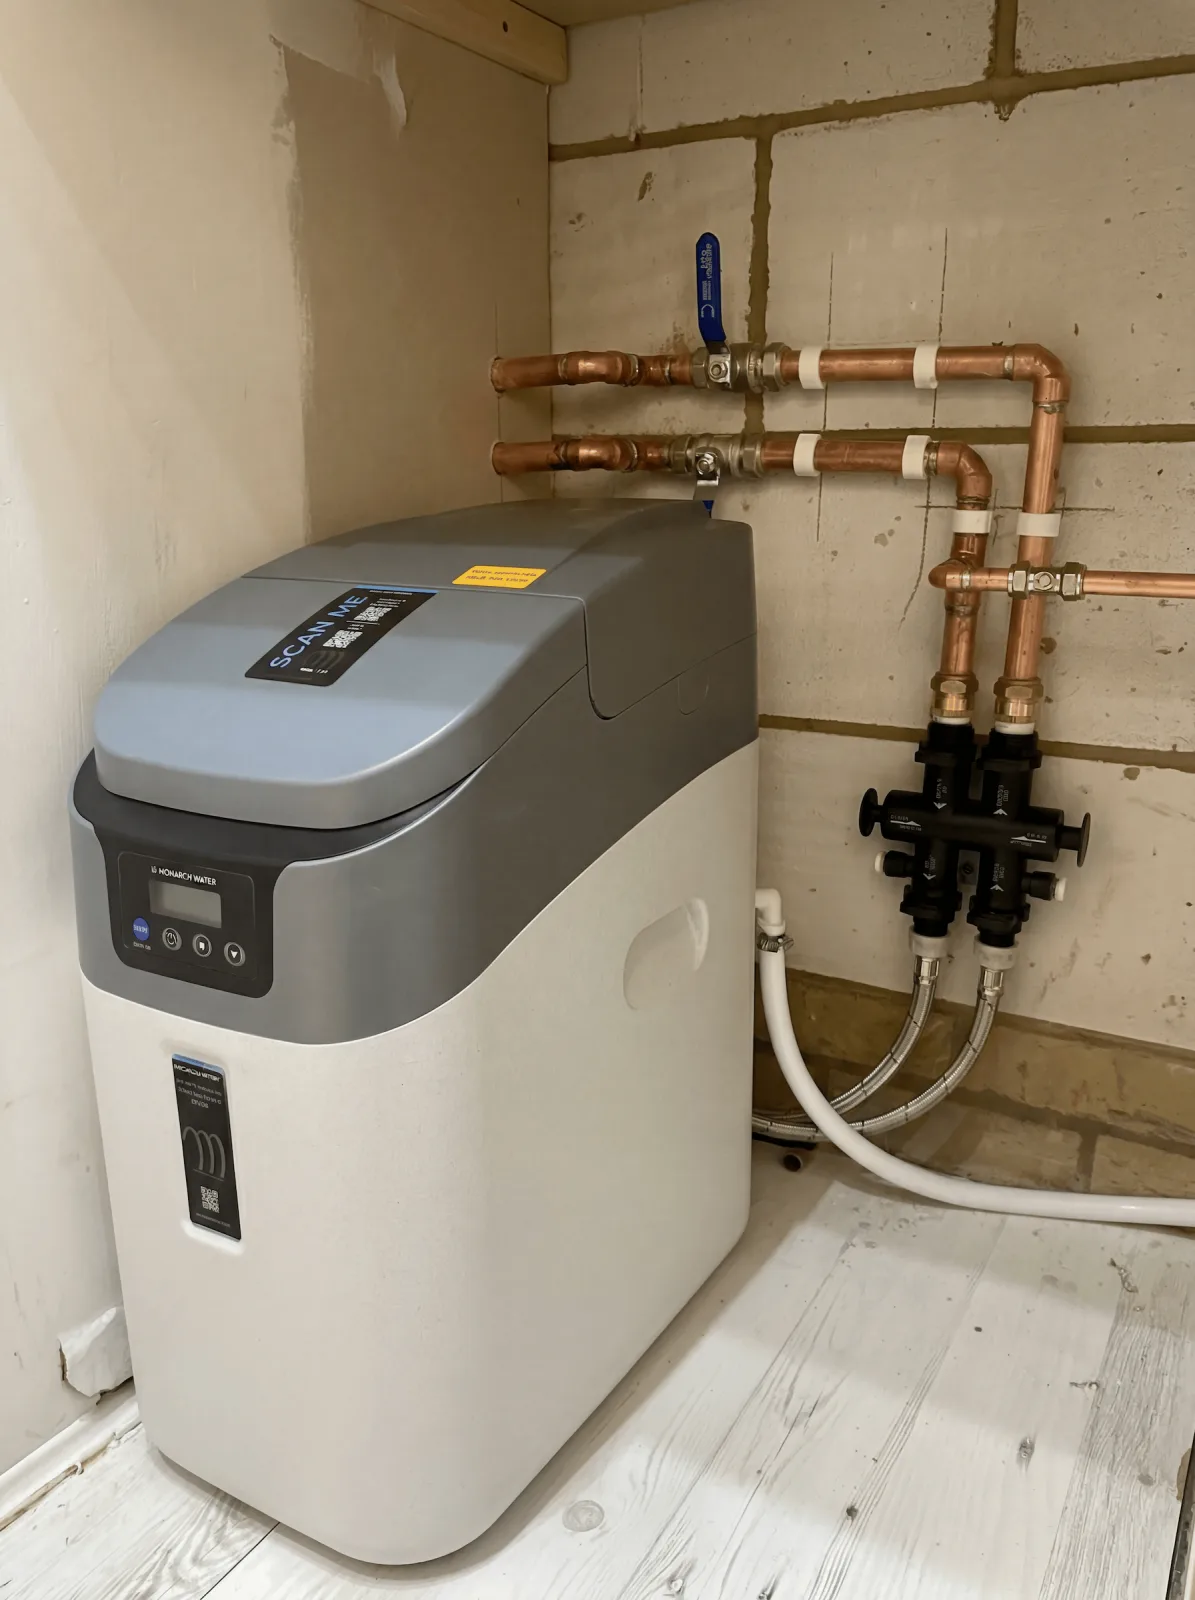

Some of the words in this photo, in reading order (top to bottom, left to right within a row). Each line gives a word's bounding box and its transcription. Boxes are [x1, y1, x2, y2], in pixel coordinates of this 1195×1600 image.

[269, 621, 335, 669] SCAN
[327, 595, 369, 618] ME
[159, 868, 192, 881] MONARCH
[193, 875, 217, 886] WATER
